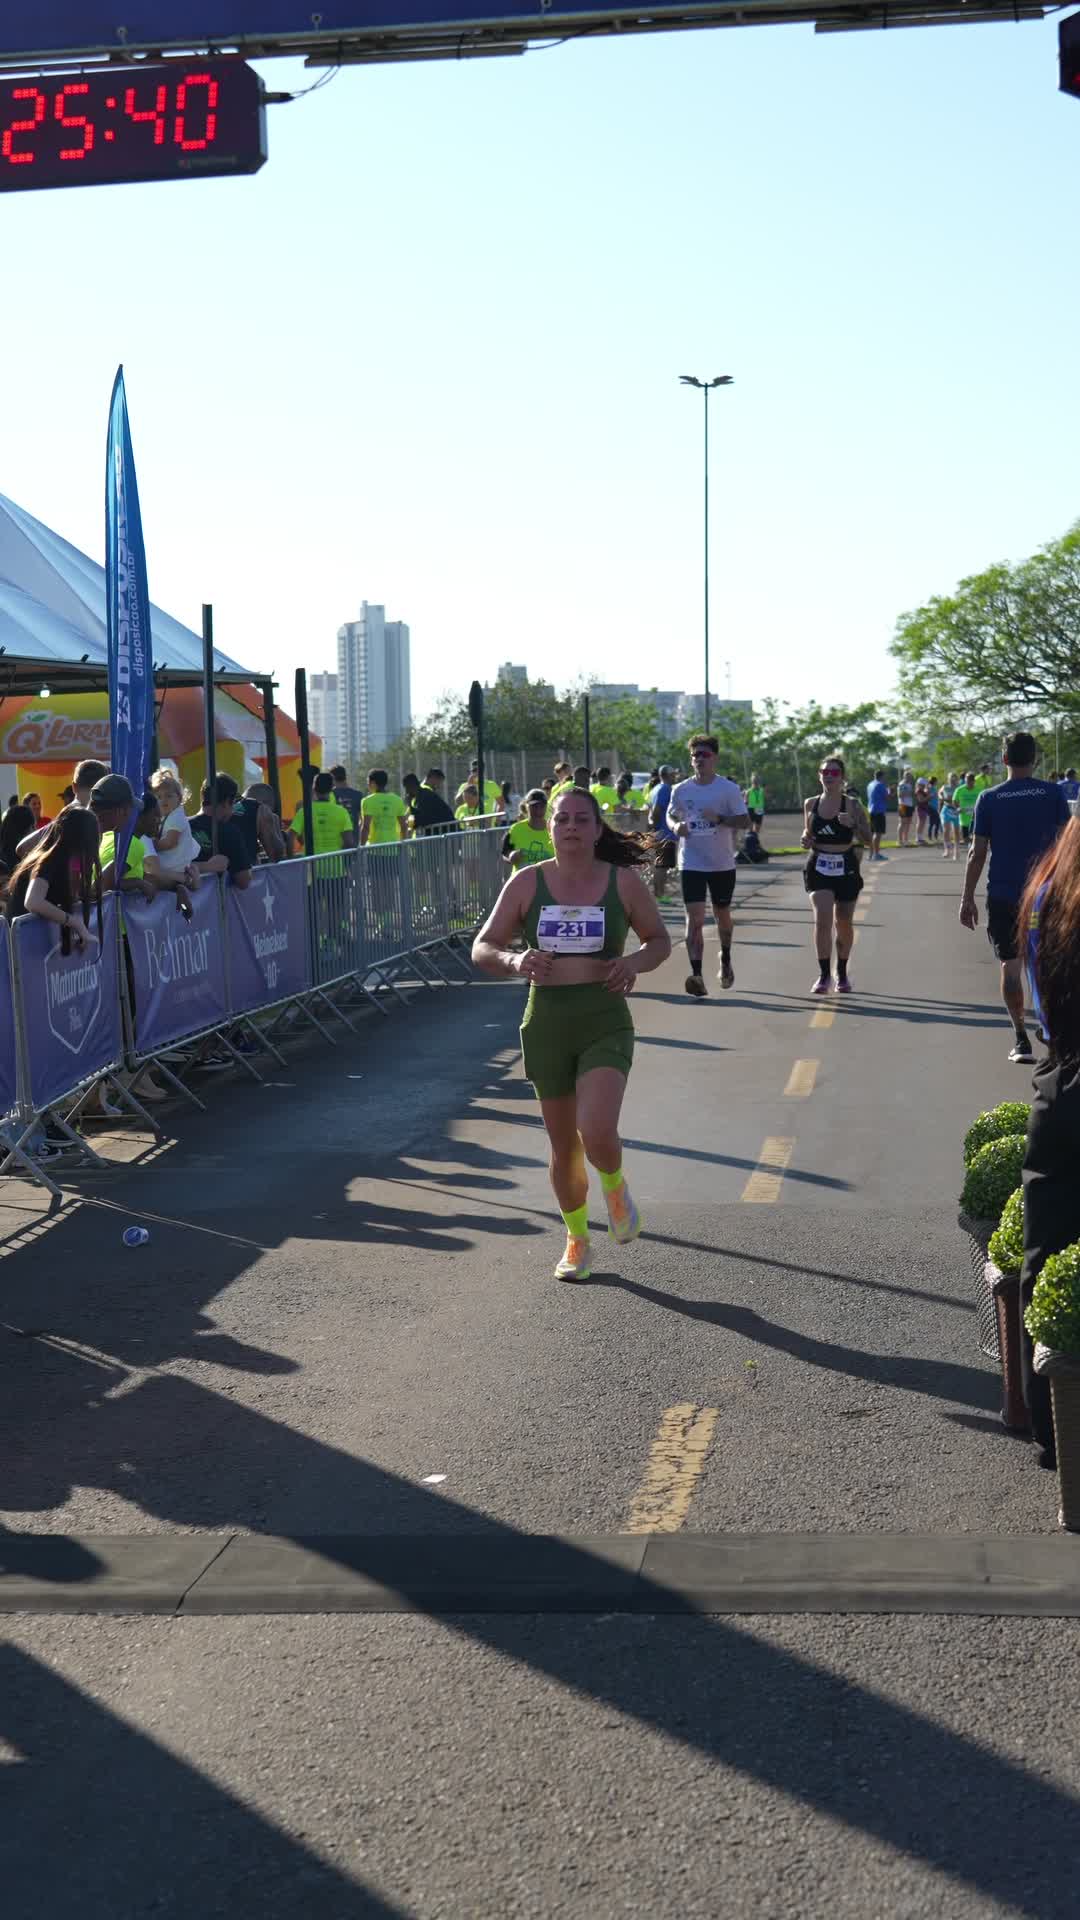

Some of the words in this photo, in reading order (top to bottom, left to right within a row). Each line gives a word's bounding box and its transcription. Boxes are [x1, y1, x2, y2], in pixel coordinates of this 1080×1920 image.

[1, 73, 219, 164] 25:40
[996, 787, 1047, 799] ORGANIZAÇÃO
[557, 921, 587, 937] 231
